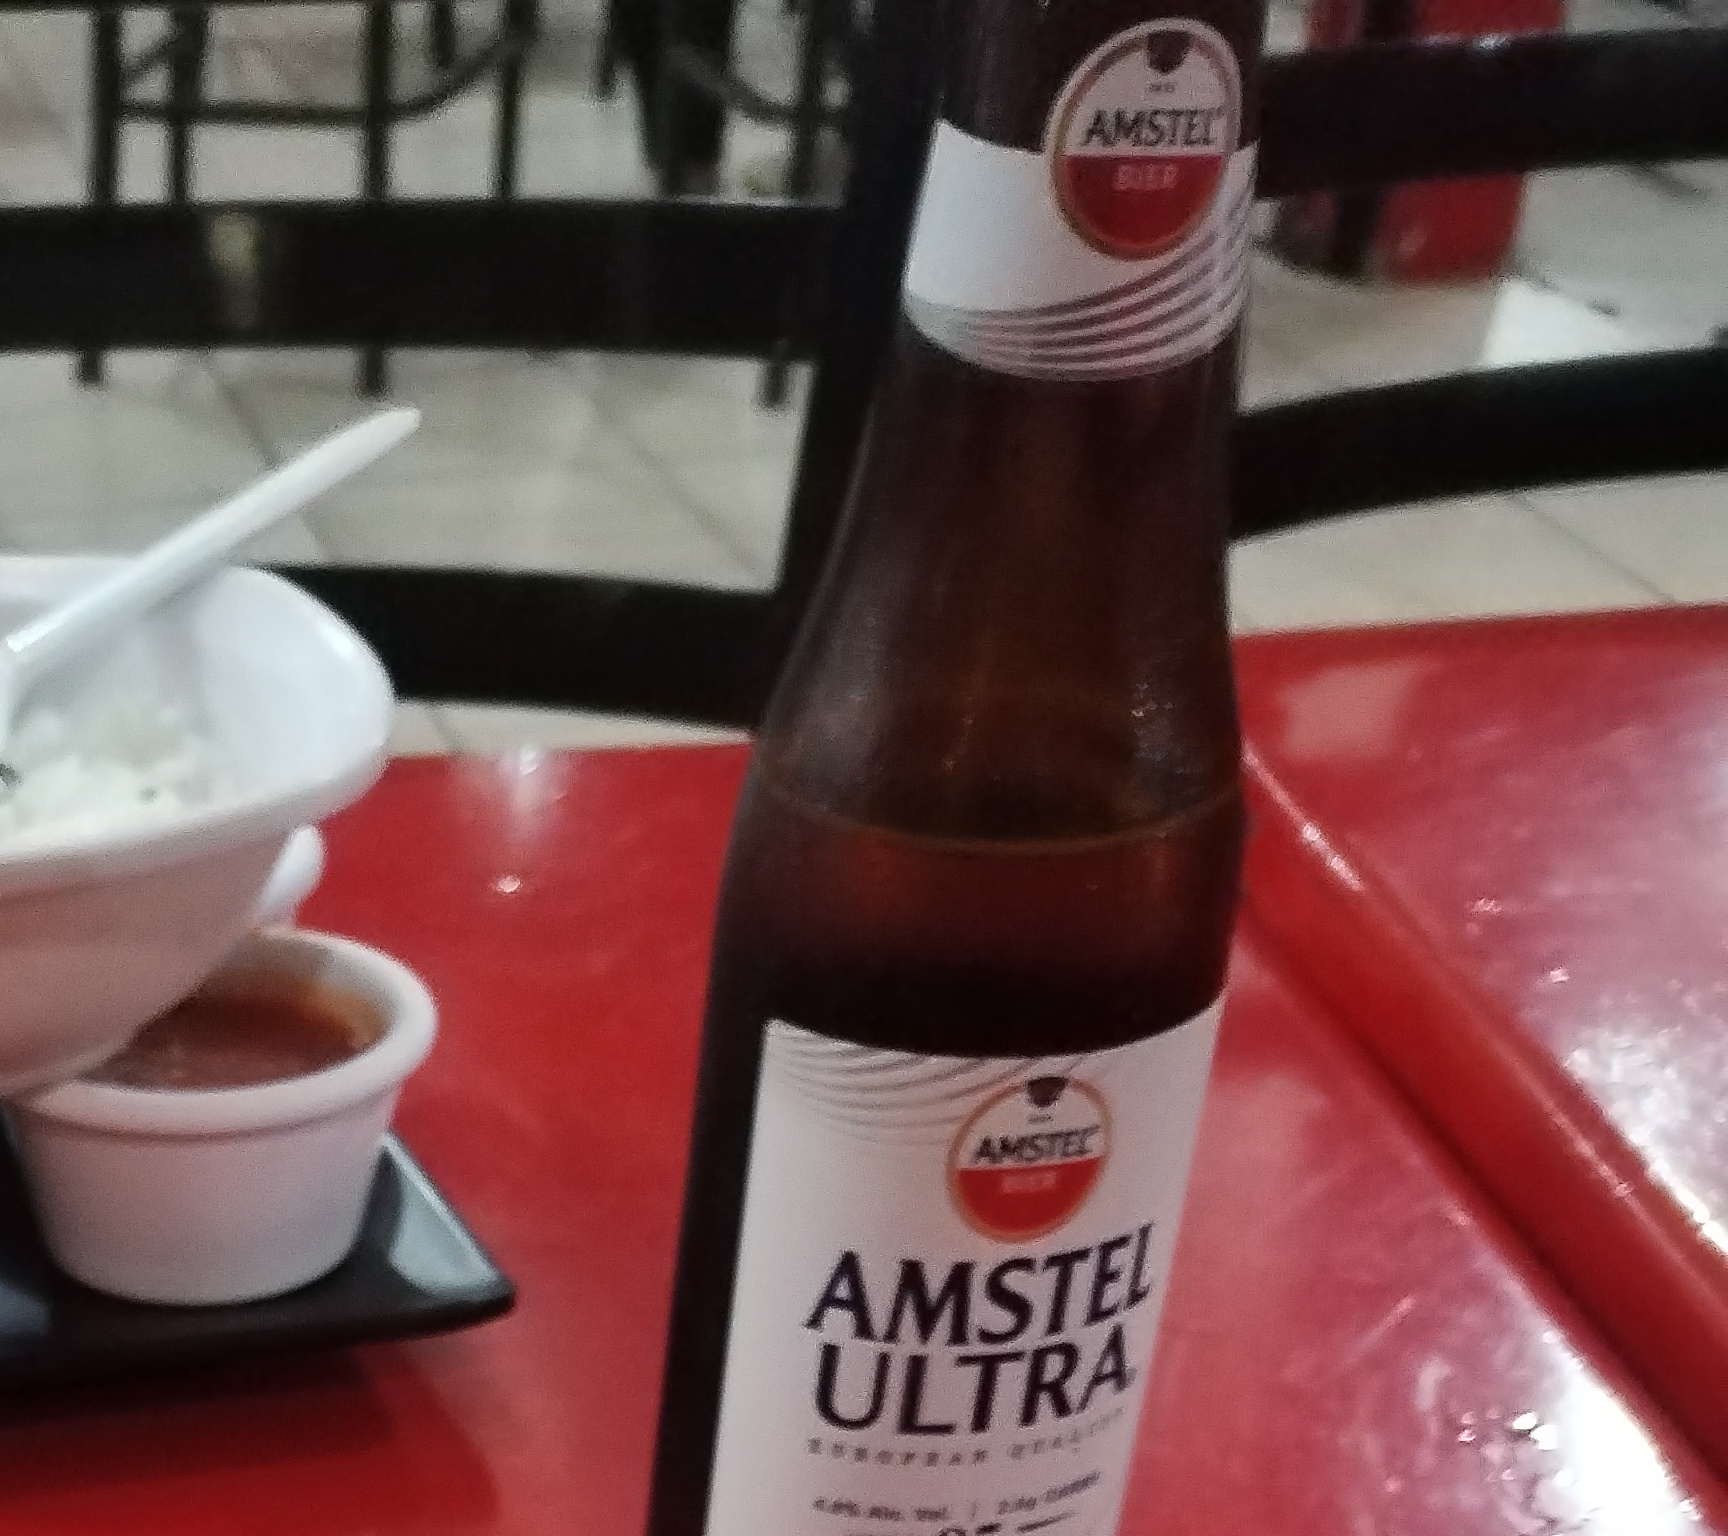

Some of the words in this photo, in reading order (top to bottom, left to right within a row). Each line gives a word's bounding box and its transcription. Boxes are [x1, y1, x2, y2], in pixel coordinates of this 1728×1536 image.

[1079, 105, 1226, 147] AMSTEL
[970, 1123, 1101, 1165] AMSTEL
[802, 1221, 1156, 1347] AMSTEL
[811, 1323, 1138, 1437] ULTRA
